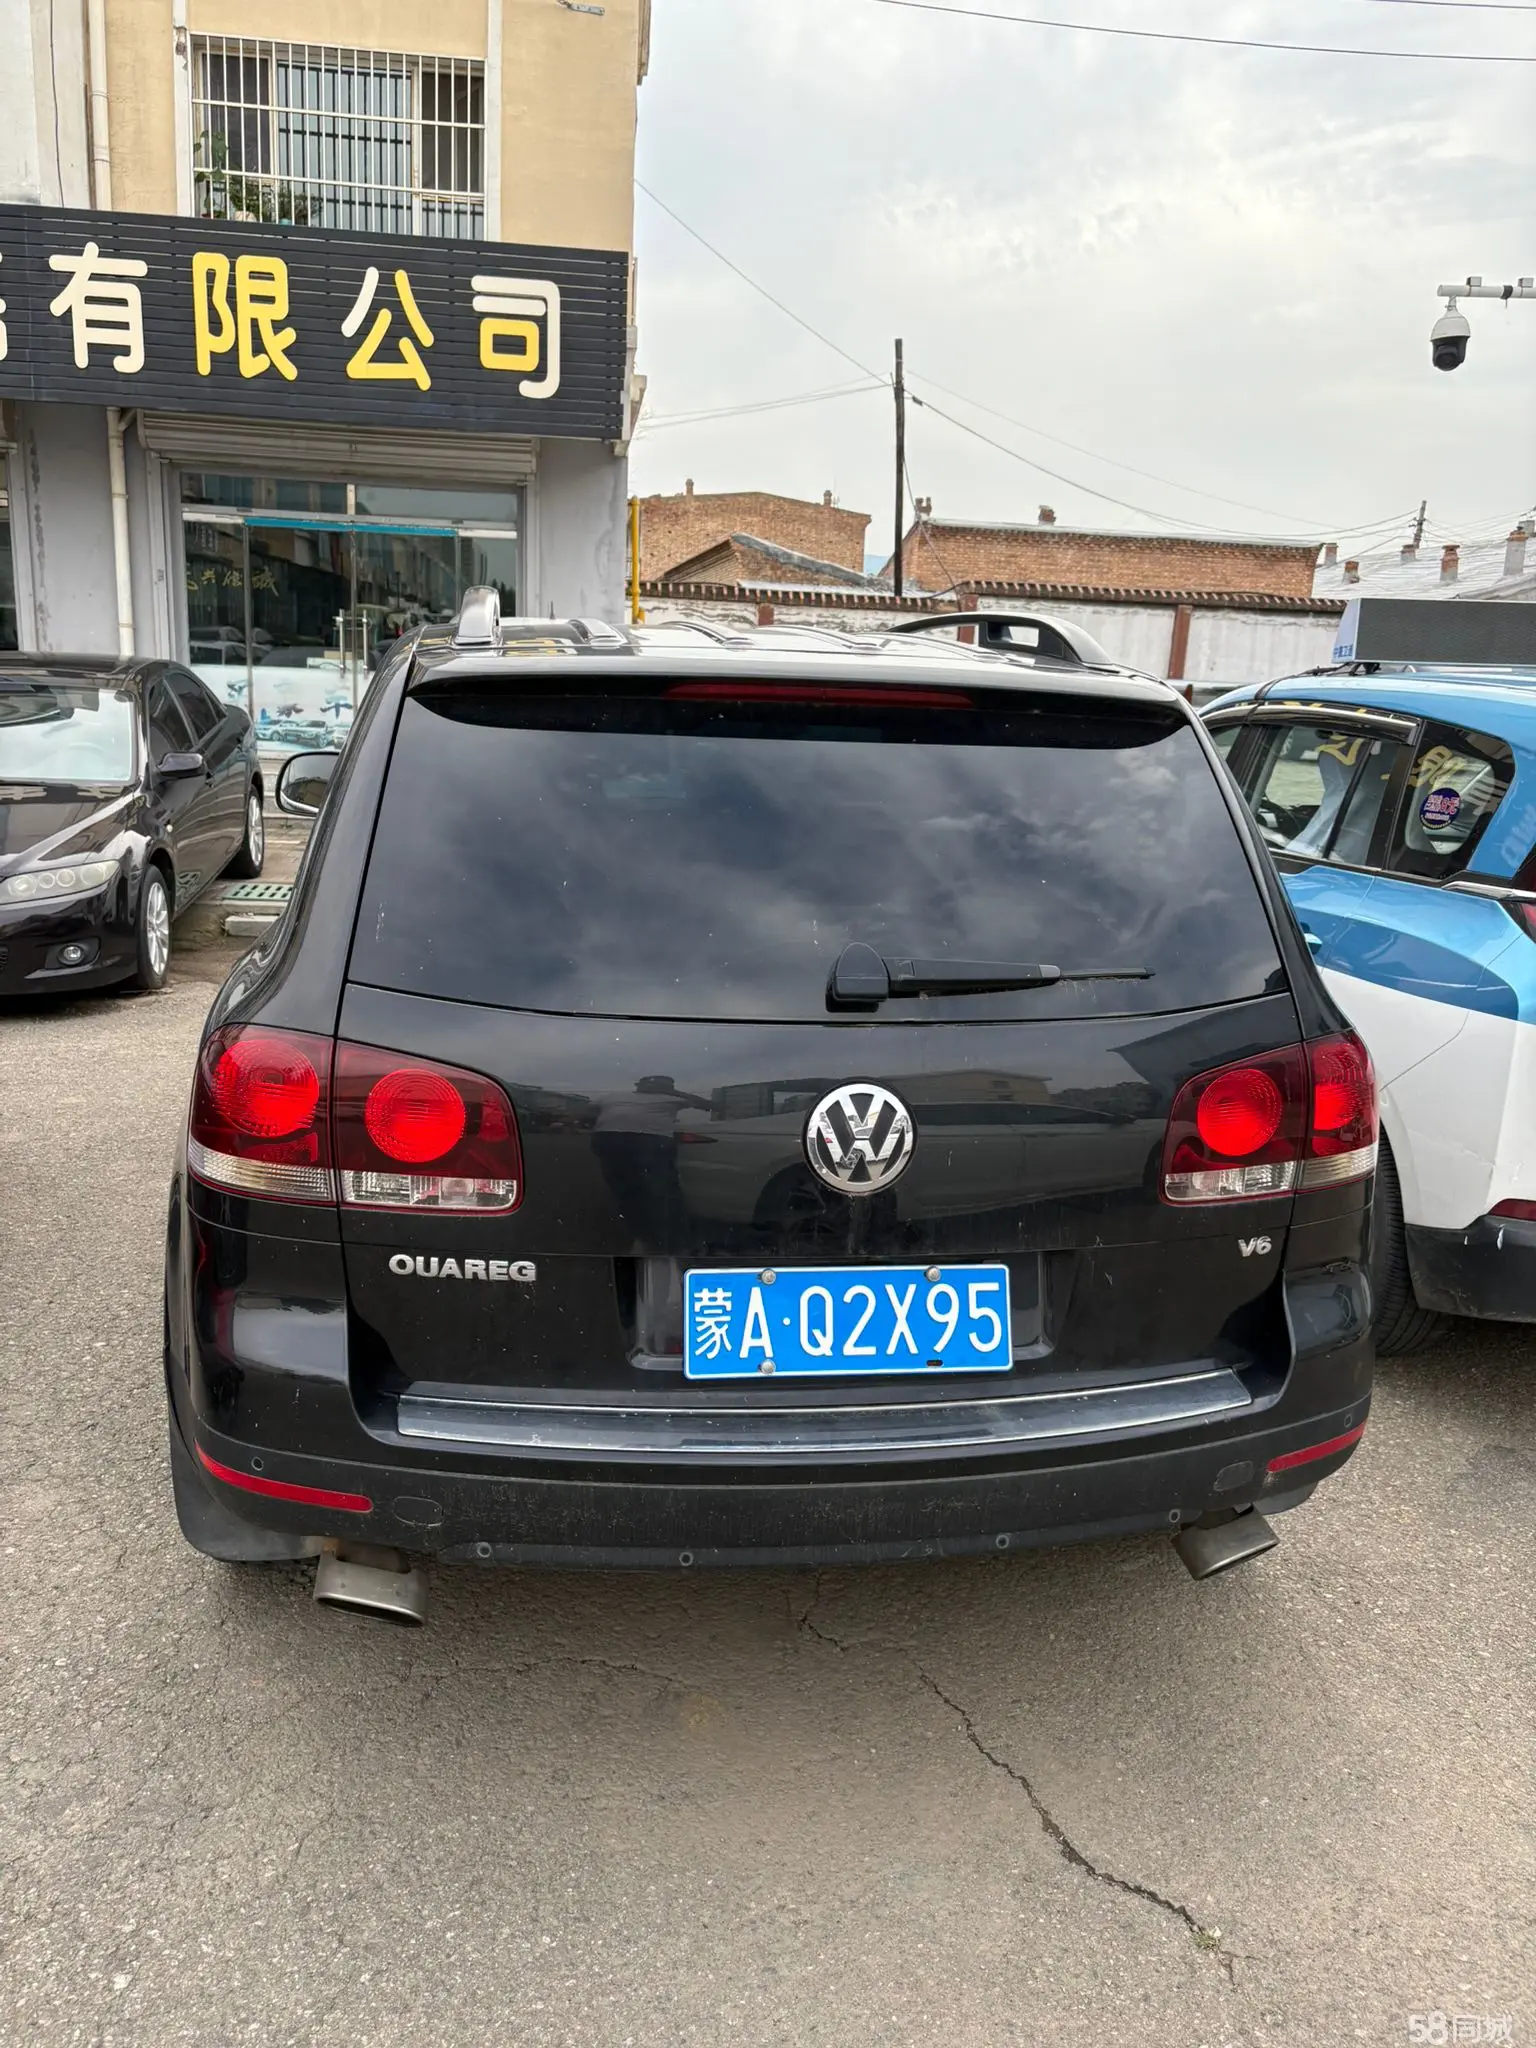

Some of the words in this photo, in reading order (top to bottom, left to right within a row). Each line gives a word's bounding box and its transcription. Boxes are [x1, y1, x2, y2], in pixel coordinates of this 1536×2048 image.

[0, 242, 561, 398] 有限公司
[1238, 1236, 1272, 1257] V6
[389, 1254, 536, 1281] OUAREG
